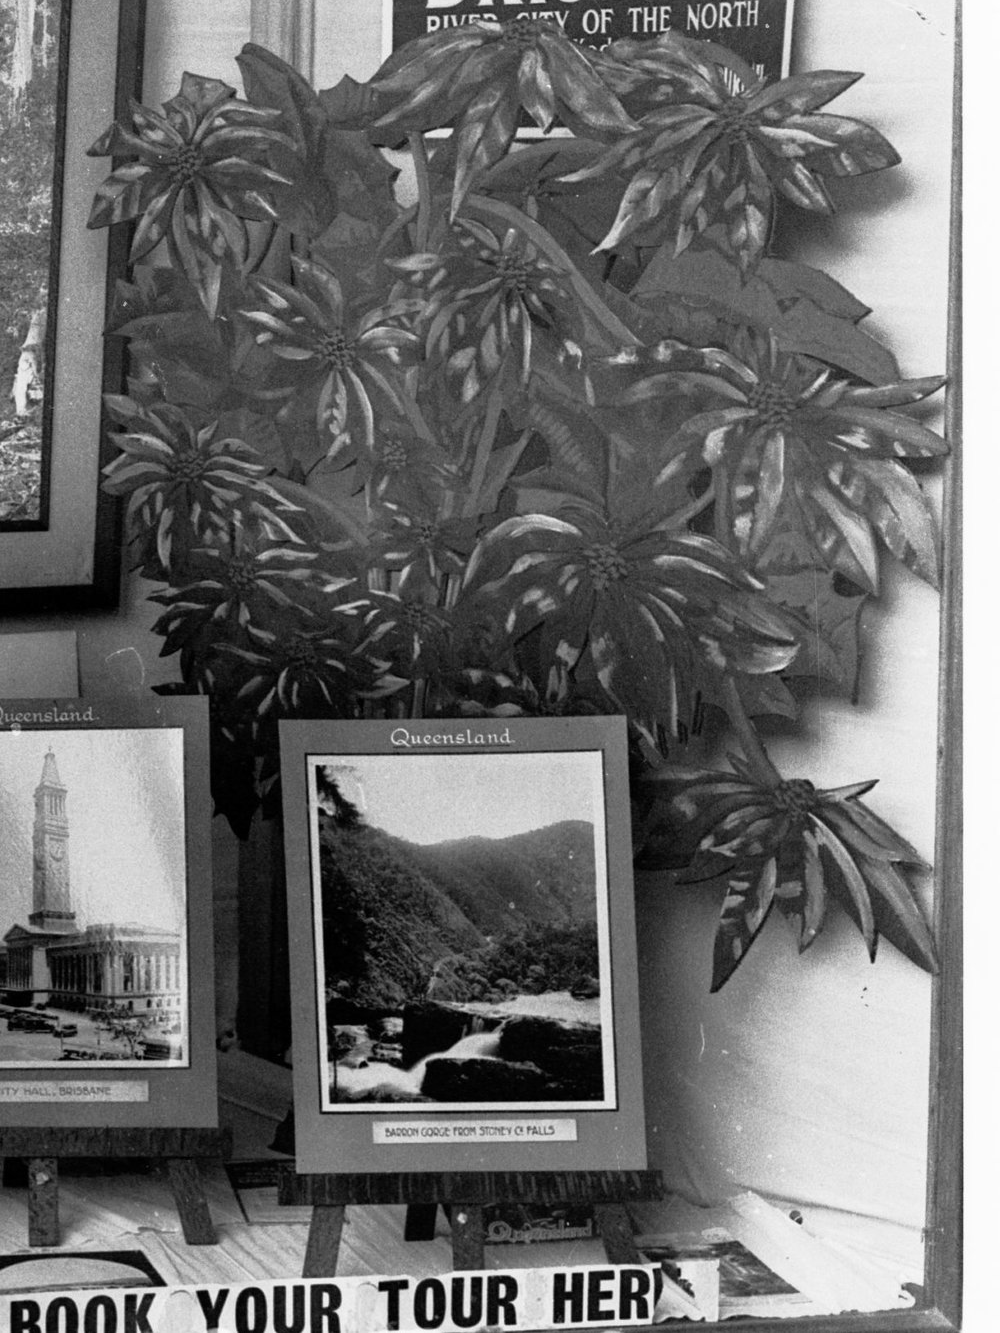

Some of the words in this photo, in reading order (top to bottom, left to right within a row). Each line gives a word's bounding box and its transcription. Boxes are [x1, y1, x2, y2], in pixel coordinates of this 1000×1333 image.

[582, 8, 615, 35] OF
[627, 5, 673, 33] THE
[58, 1086, 113, 1097] BRISBANE
[384, 1127, 419, 1138] BARRON
[421, 1127, 450, 1137] GORGE
[452, 1126, 477, 1137] FROM
[479, 1125, 512, 1137] STONEY
[526, 1125, 556, 1136] FALLS
[10, 1292, 156, 1333] BOOK
[195, 1283, 342, 1333] YOUR
[378, 1275, 519, 1331] TOUR
